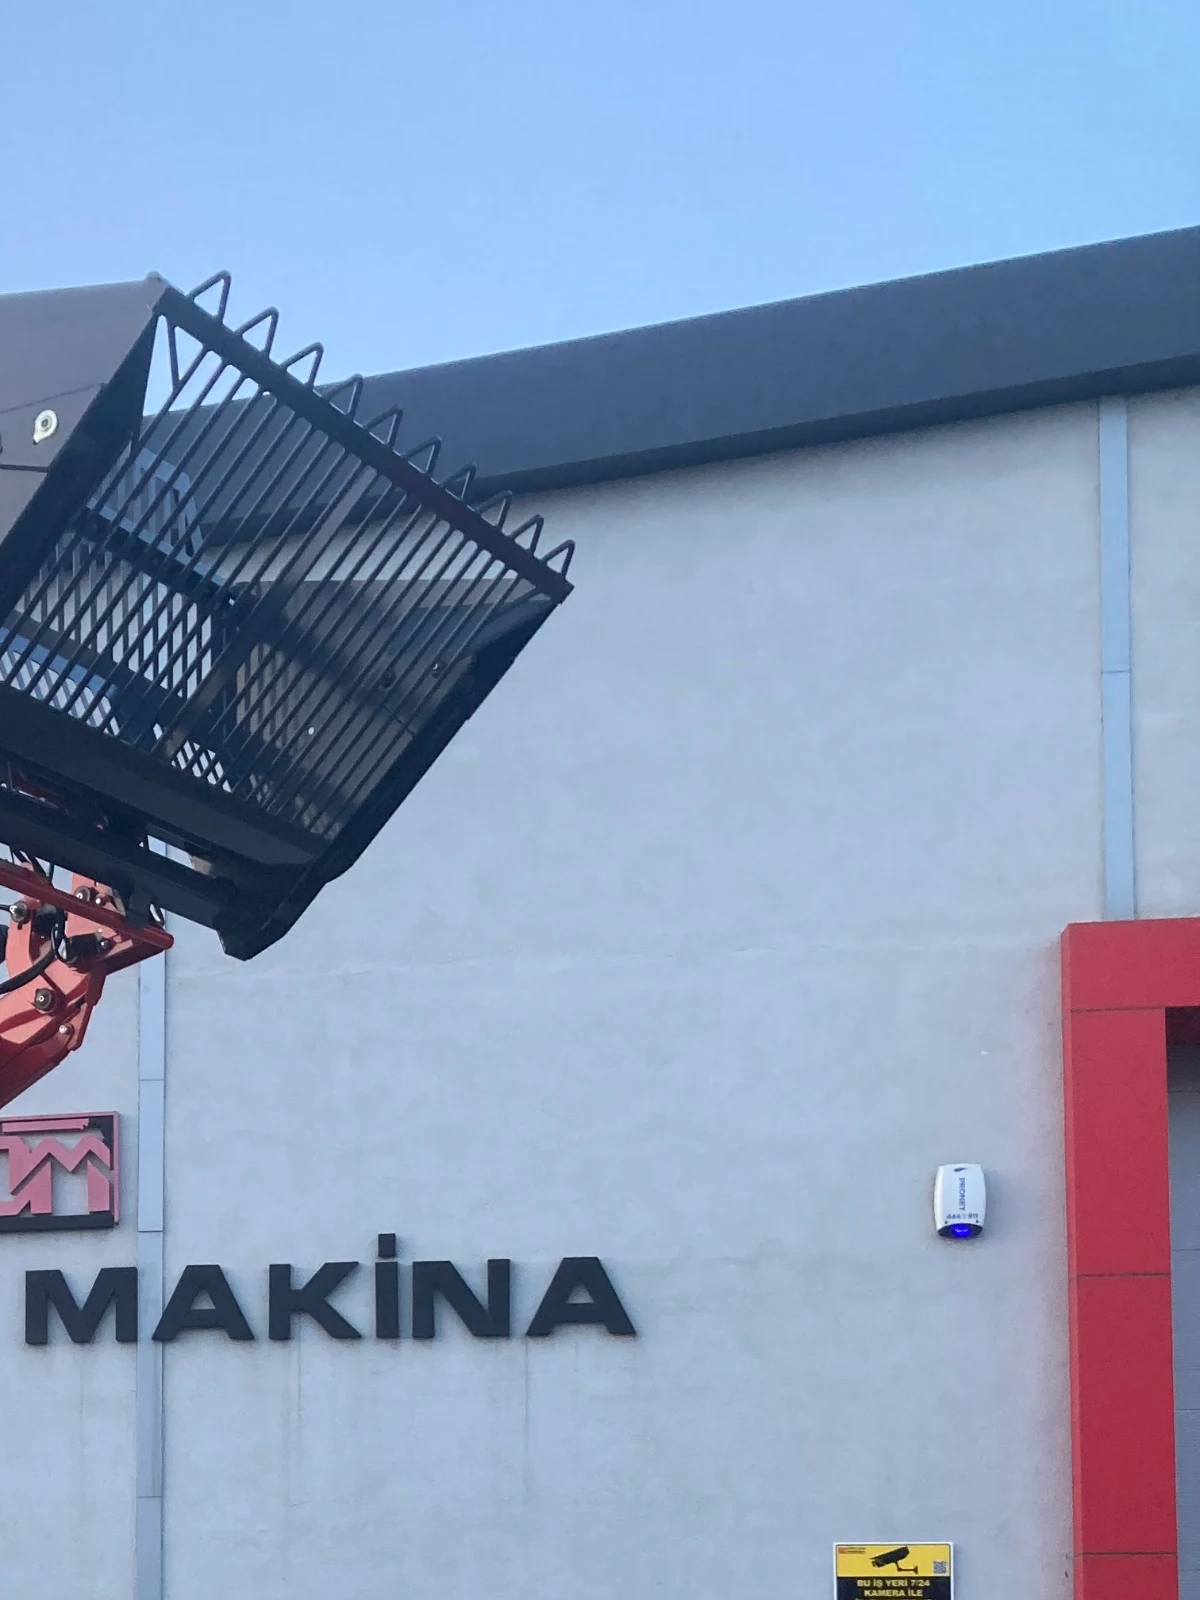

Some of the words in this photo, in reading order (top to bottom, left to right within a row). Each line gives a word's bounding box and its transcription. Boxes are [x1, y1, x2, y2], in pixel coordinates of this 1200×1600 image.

[958, 1177, 966, 1211] PRONET
[23, 1233, 638, 1346] MAKİNA
[857, 1579, 871, 1587] BU
[886, 1578, 908, 1587] YERİ
[864, 1588, 905, 1597] KAMERA
[907, 1587, 923, 1597] İLE
